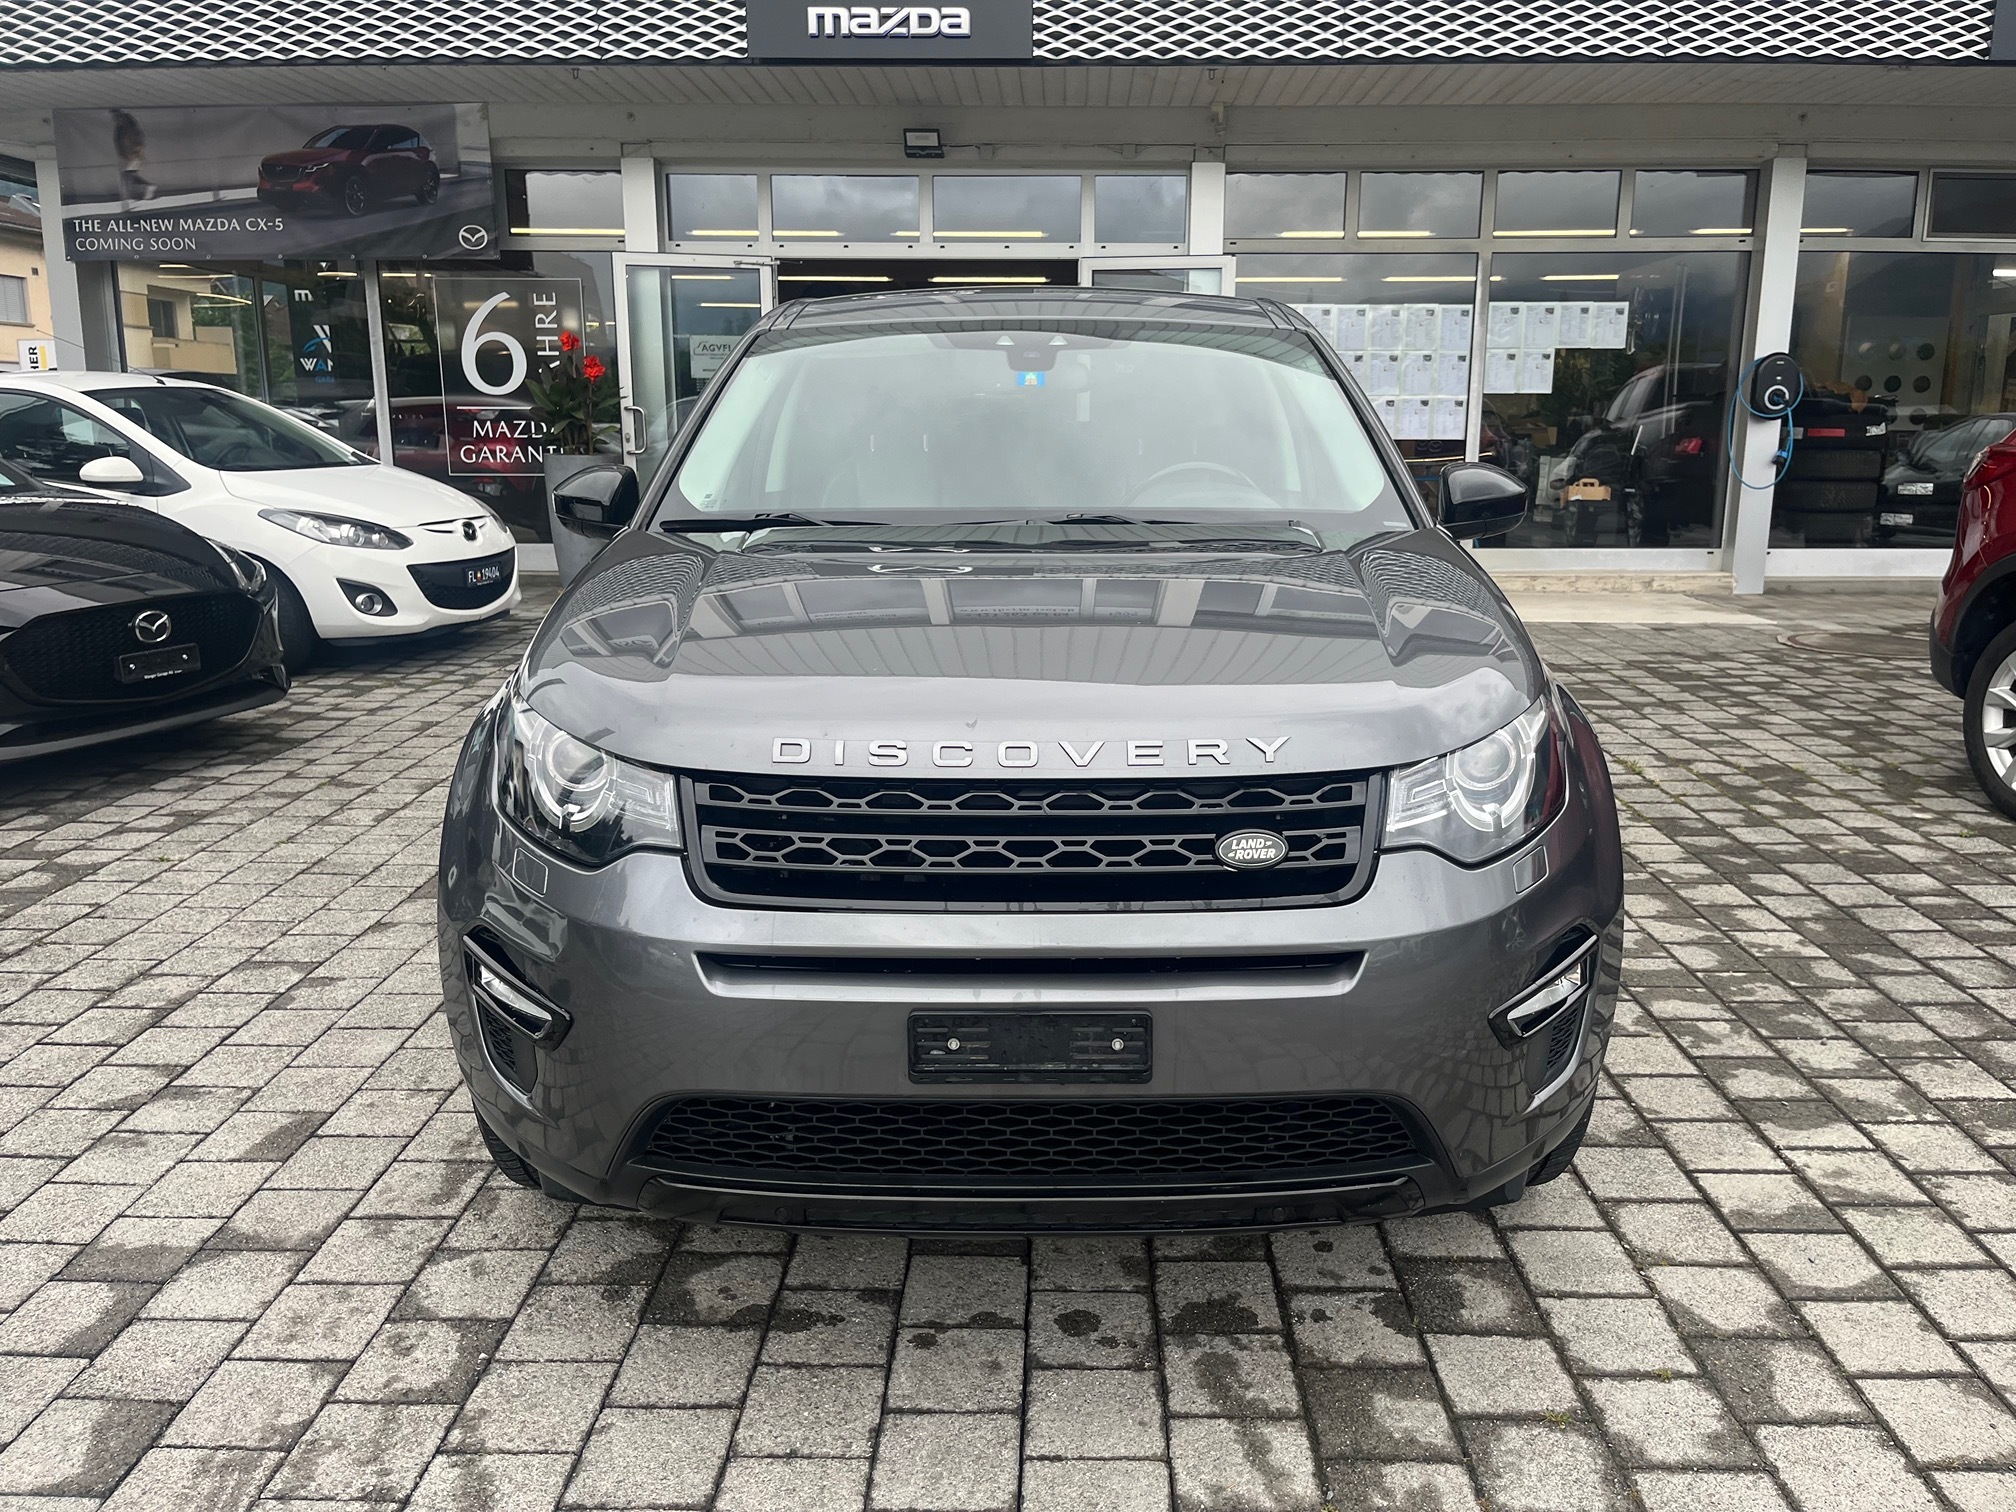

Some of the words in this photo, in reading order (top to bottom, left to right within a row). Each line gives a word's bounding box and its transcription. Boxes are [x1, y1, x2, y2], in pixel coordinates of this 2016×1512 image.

[73, 219, 102, 232] THE
[107, 218, 174, 232] ALL-NEW
[179, 218, 241, 232] MAZDA
[245, 217, 284, 231] CX-5
[75, 237, 144, 251] COMING
[150, 237, 196, 251] SOON
[461, 291, 528, 396] 6
[472, 419, 555, 439] MAZD
[468, 570, 476, 583] FL
[771, 736, 1292, 768] DISCOVERY
